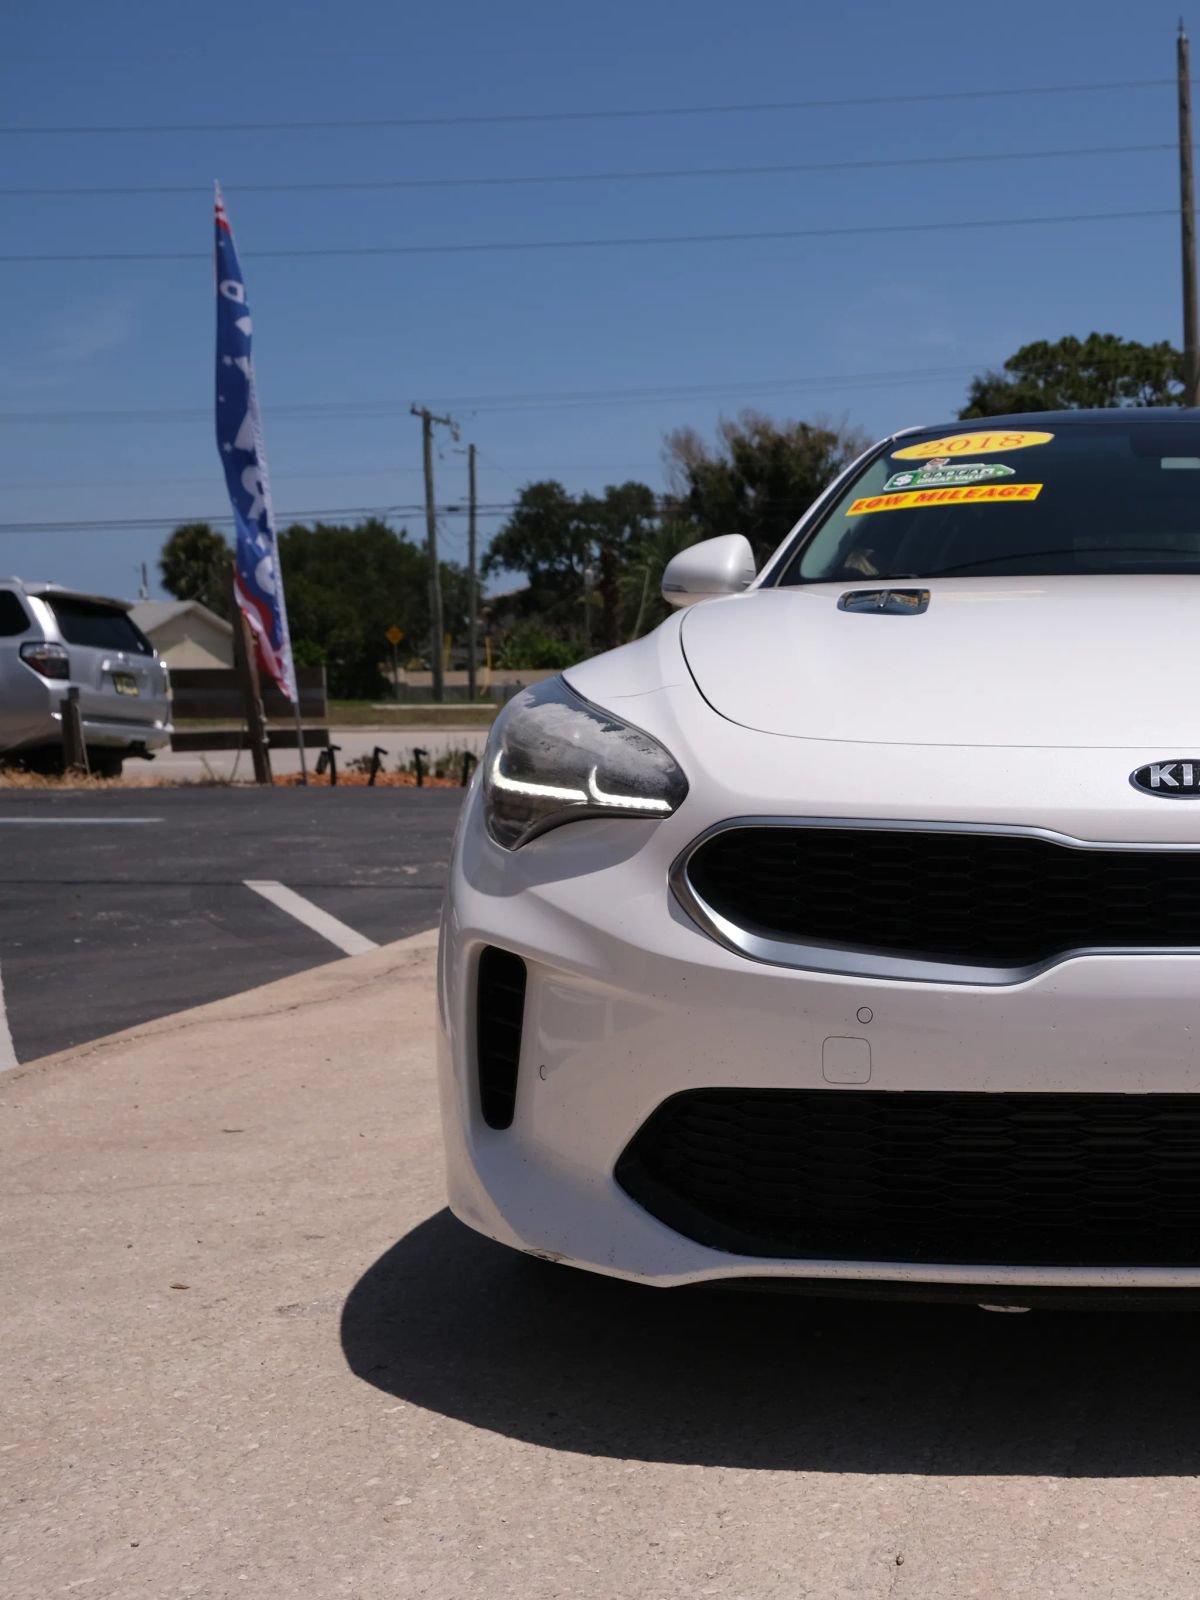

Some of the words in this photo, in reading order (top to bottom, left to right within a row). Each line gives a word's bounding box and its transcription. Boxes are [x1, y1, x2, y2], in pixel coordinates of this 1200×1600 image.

[917, 434, 1025, 456] 2018
[851, 494, 910, 512] LOW
[913, 486, 1036, 503] MILEAGE
